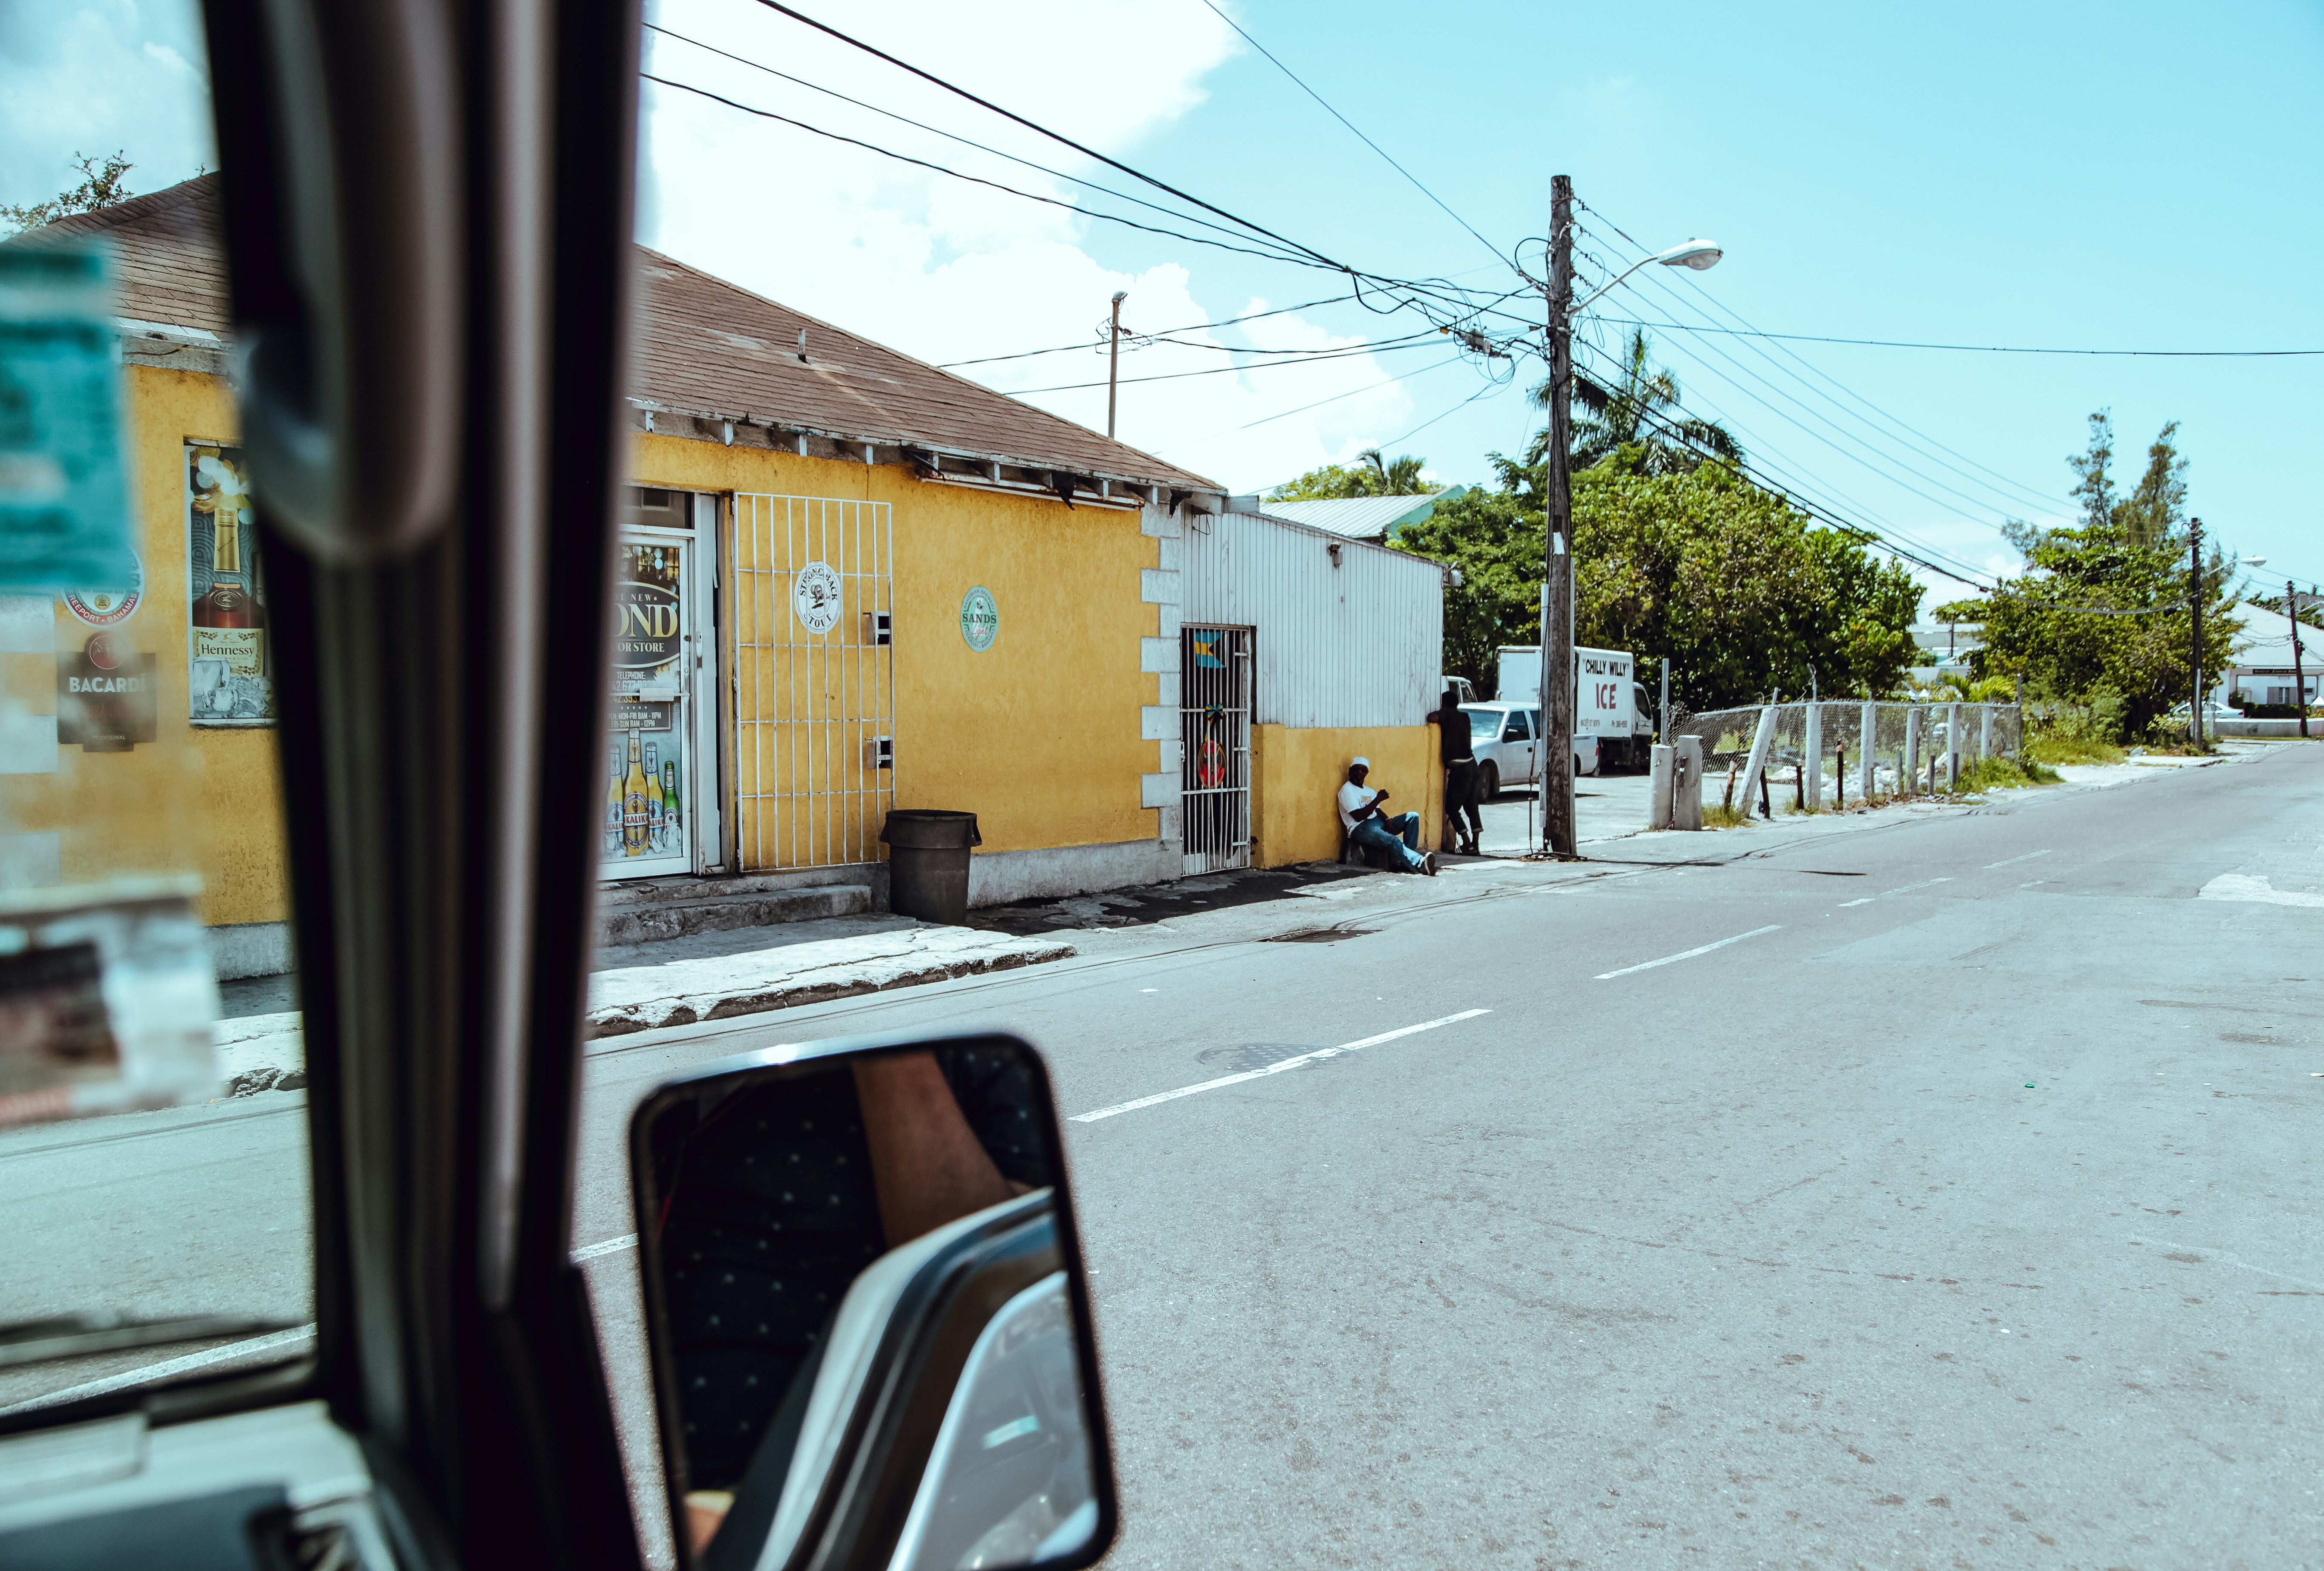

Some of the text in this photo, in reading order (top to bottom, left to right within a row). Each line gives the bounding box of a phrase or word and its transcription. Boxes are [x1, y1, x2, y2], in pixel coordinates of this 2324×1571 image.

[825, 573, 838, 601] BACK
[631, 593, 652, 602] NEW
[964, 589, 995, 611] BAHAMIAN BREWERY
[107, 593, 137, 623] BAHAMAS
[613, 603, 678, 637] OND
[962, 613, 997, 624] SANDS
[972, 623, 989, 640] Light
[981, 627, 995, 648] BAHAMAS
[201, 644, 255, 657] Hennessy
[633, 642, 665, 652] STORE
[616, 671, 646, 680] TELEPHONE:
[1596, 682, 1616, 710] ICE
[626, 815, 646, 824] KALIK
